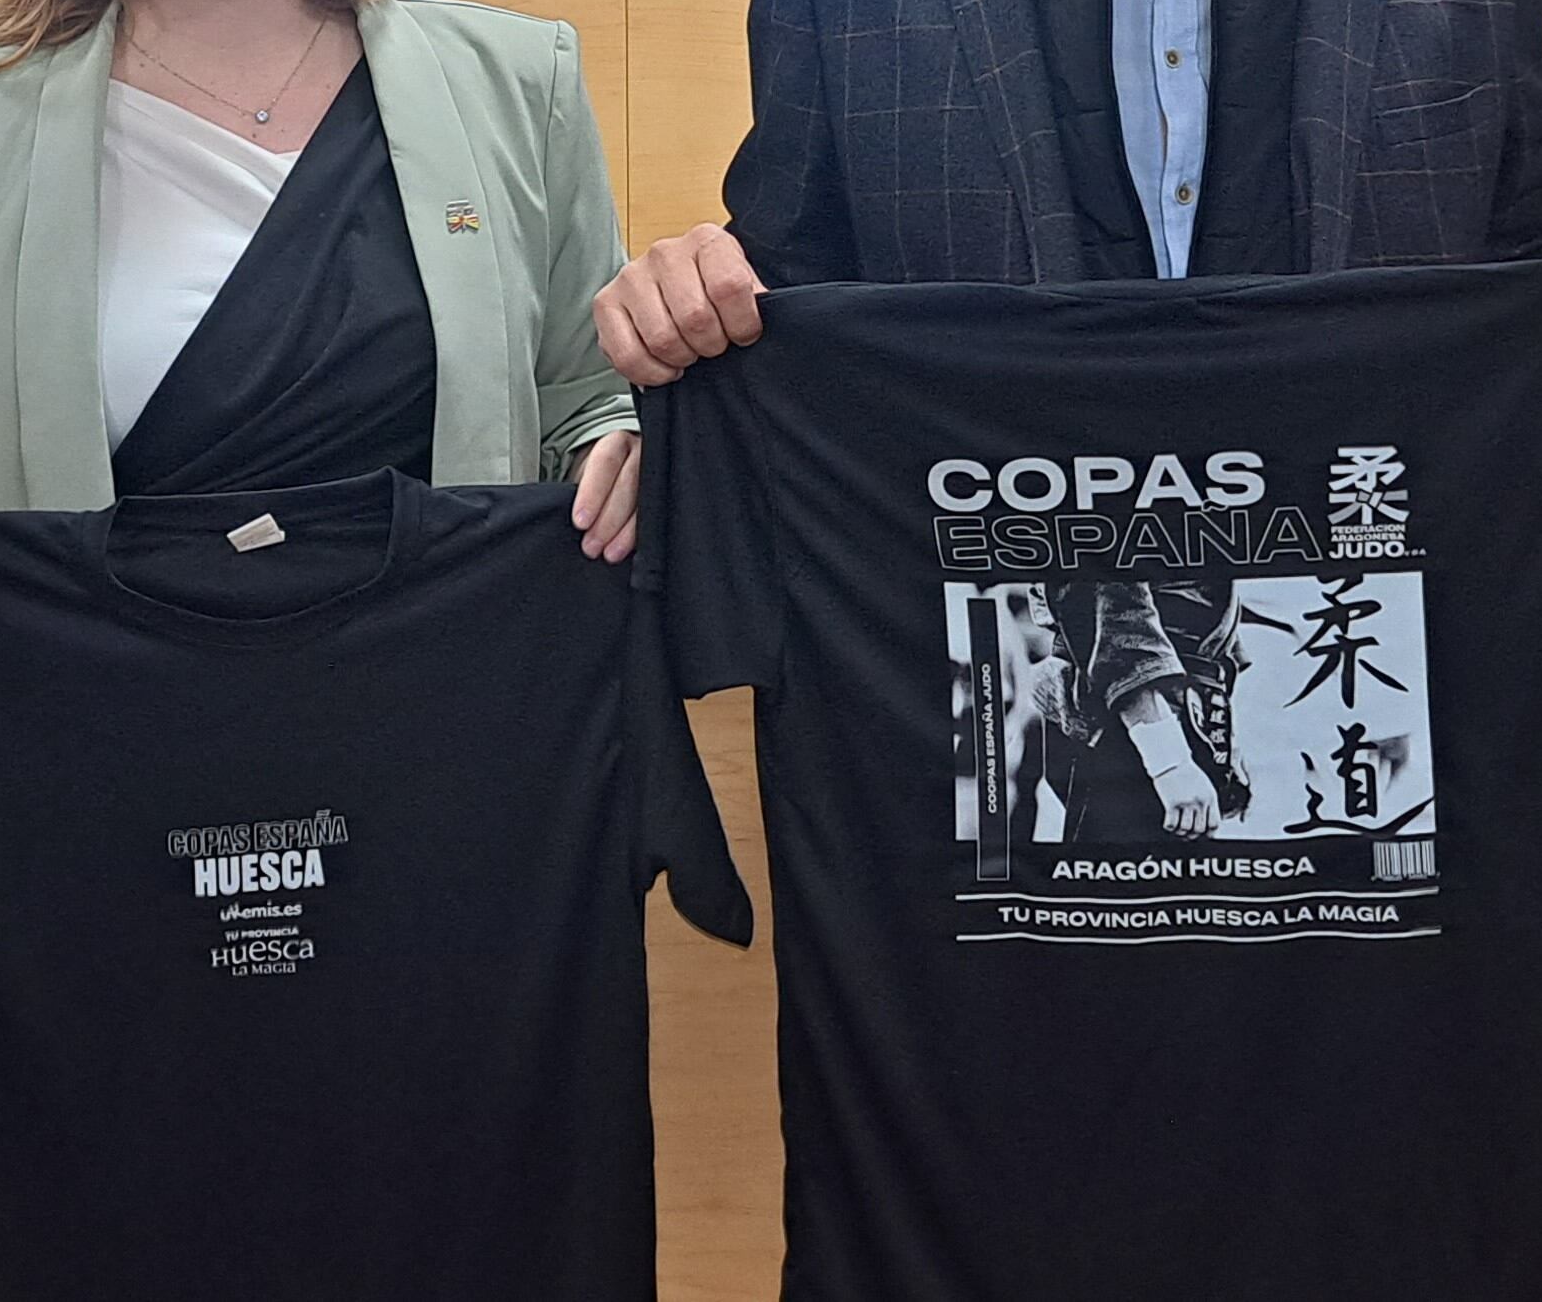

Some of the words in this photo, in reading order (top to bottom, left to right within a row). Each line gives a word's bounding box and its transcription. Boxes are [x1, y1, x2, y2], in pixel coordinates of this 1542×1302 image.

[927, 451, 1265, 512] COPAS
[934, 498, 1323, 570] ESPAÑA
[1329, 541, 1405, 558] JUDO
[981, 663, 993, 701] JUDO
[982, 709, 995, 756] ESPAÑA
[987, 758, 997, 814] COOPAS
[168, 823, 250, 857] COPAS
[254, 809, 349, 852] ESPAÑA
[194, 849, 325, 897] HUESCA
[1053, 855, 1182, 881] ARAGÓN
[1189, 857, 1315, 878] HUESCA
[226, 930, 239, 942] TU
[241, 925, 299, 940] PROVINCIA
[998, 906, 1030, 924] TU
[1035, 908, 1171, 928] PROVINCIA
[1176, 907, 1278, 928] HUESCA
[1283, 905, 1314, 923] LA
[1318, 904, 1400, 923] MAGIA
[211, 938, 315, 967] Huesca
